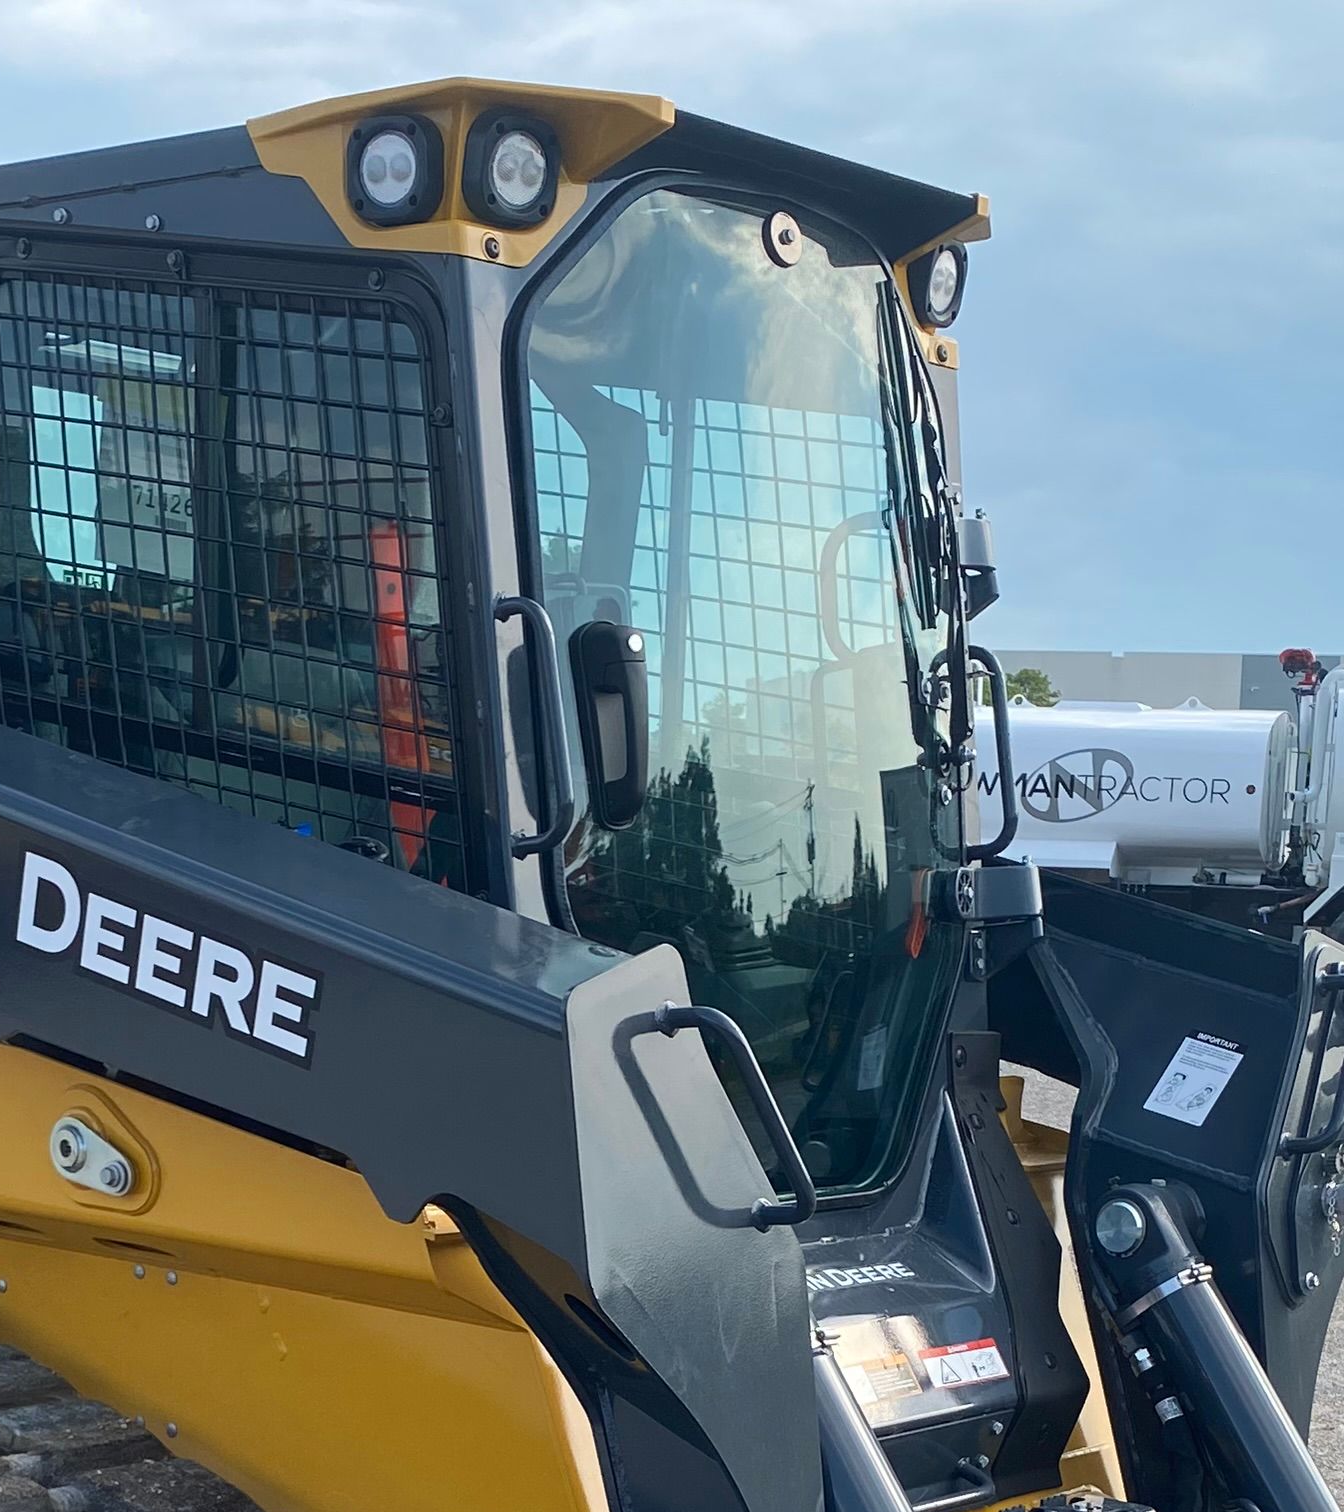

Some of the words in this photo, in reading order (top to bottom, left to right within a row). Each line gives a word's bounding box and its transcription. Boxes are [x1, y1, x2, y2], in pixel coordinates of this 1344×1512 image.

[16, 851, 317, 1058] DEERE
[1196, 1032, 1240, 1051] IMPORTANT
[828, 1262, 916, 1286] DEERE
